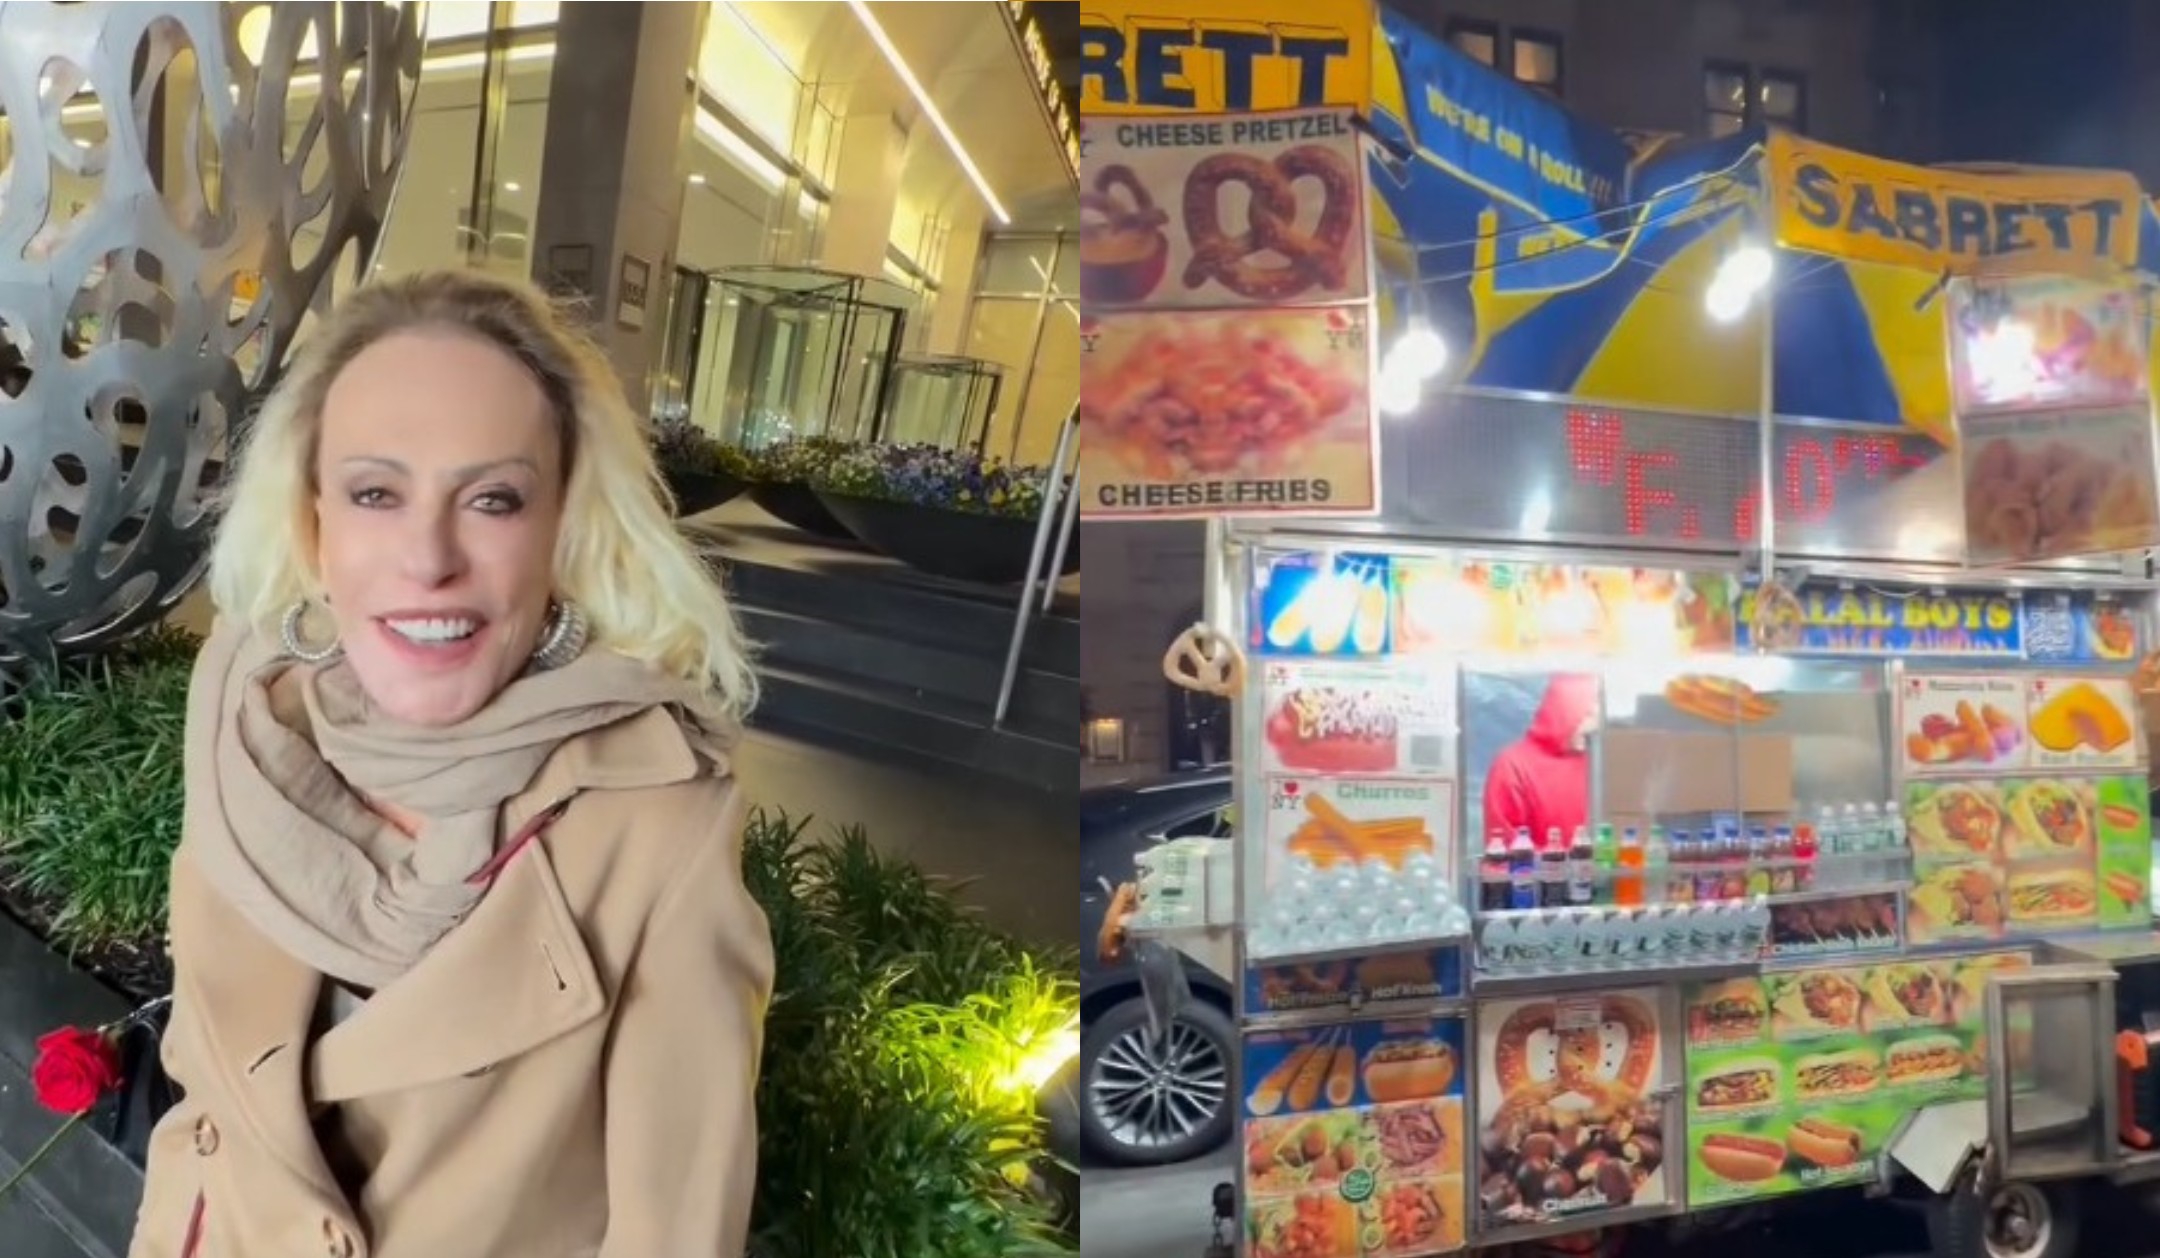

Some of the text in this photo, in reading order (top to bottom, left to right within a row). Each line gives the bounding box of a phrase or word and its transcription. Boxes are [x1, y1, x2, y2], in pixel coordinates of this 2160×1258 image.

[1080, 25, 1349, 110] RETT
[1116, 114, 1348, 148] CHEESE PRETZEL
[1793, 163, 2124, 257] SABRETT
[1097, 478, 1331, 507] CHEESE FRIES
[1902, 595, 2012, 630] BOYS
[1335, 782, 1432, 801] Churros
